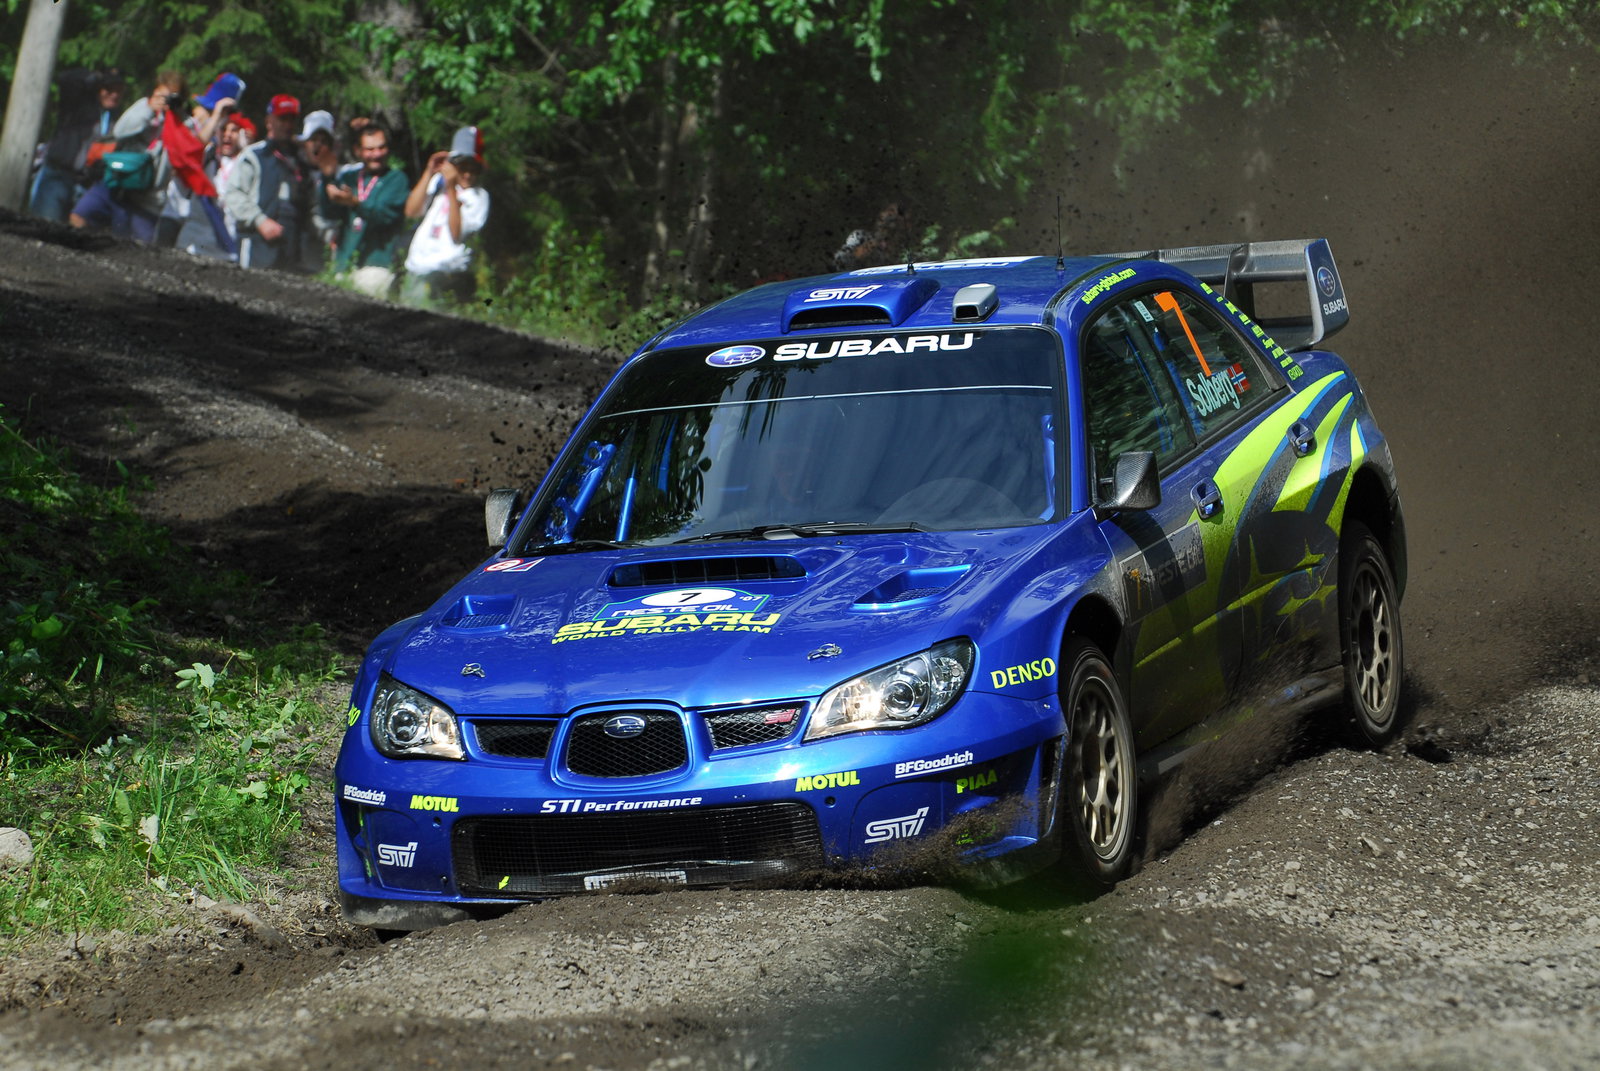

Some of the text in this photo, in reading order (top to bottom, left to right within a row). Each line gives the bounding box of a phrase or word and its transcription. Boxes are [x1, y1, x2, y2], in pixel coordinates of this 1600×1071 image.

[1154, 291, 1212, 377] 7
[773, 333, 974, 361] SUBARU
[1186, 372, 1240, 416] Solberg
[680, 593, 702, 603] 7
[611, 606, 699, 617] NESTE
[551, 624, 772, 645] WORLD RALLY TEAM
[554, 613, 781, 637] SUBARU
[991, 657, 1056, 689] DENSO
[895, 751, 973, 777] BFGoodrich
[795, 771, 860, 792] MOTUL
[956, 769, 998, 794] PIAA
[343, 784, 387, 804] BFGoodrich
[409, 795, 459, 812] MOTUL
[540, 796, 702, 813] STI Performance
